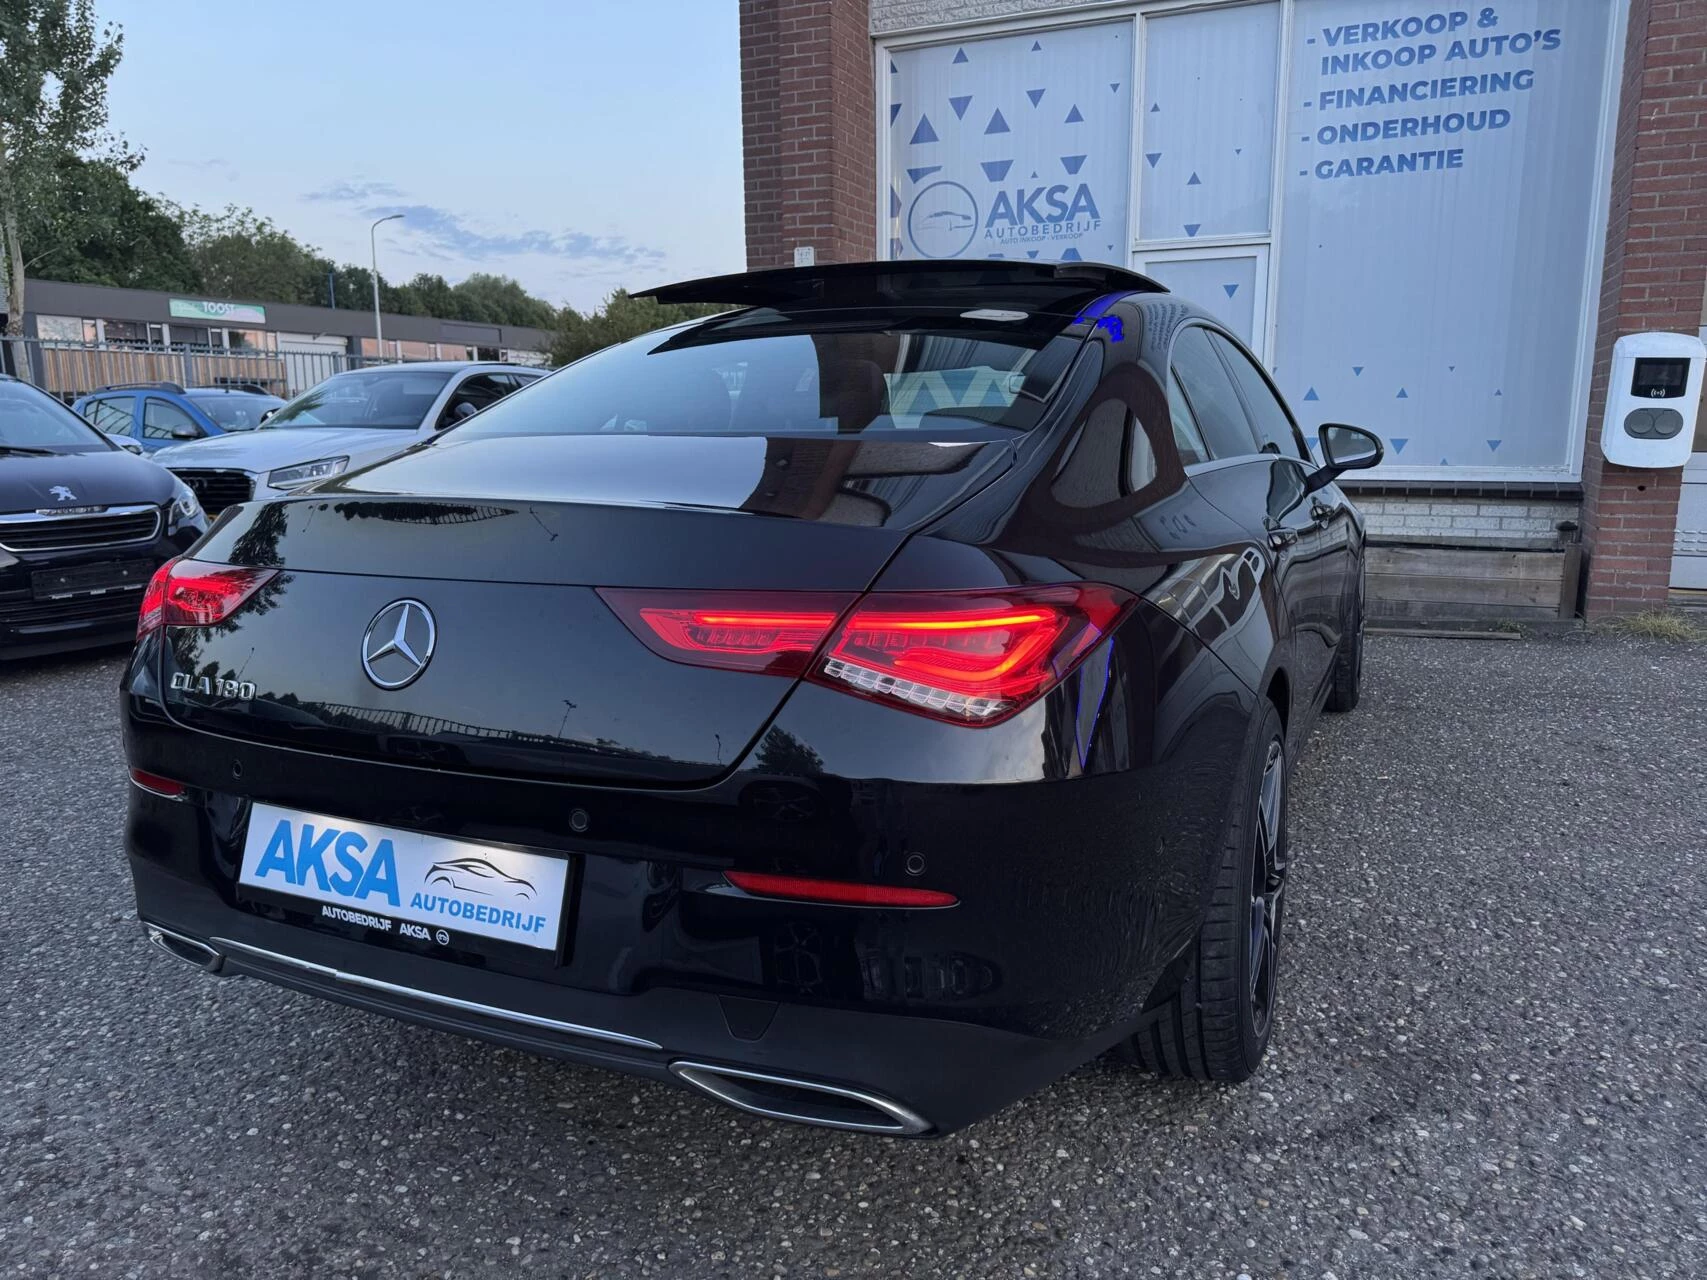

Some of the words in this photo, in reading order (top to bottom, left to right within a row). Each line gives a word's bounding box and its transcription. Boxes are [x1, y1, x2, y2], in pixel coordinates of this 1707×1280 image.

[1322, 11, 1468, 47] VERKOOP
[1477, 7, 1499, 29] &
[1321, 44, 1437, 76] INKOOP
[1319, 69, 1535, 111] FINANCIERING
[1317, 108, 1511, 145] ONDERHOUD
[1314, 148, 1464, 180] GARANTIE
[984, 183, 1101, 229] AKSA
[984, 219, 1101, 240] AUTOBEDRIJF
[1000, 237, 1019, 245] AUTO
[1020, 235, 1046, 244] INKOOP
[1051, 232, 1083, 241] VERKOOP
[170, 672, 213, 695] CLA
[215, 678, 257, 701] 180
[255, 819, 401, 908] AKSA
[321, 905, 392, 932] AUTOBEDRIJF
[399, 922, 432, 942] AKSA
[410, 892, 547, 934] AUTOBEDRIJF
